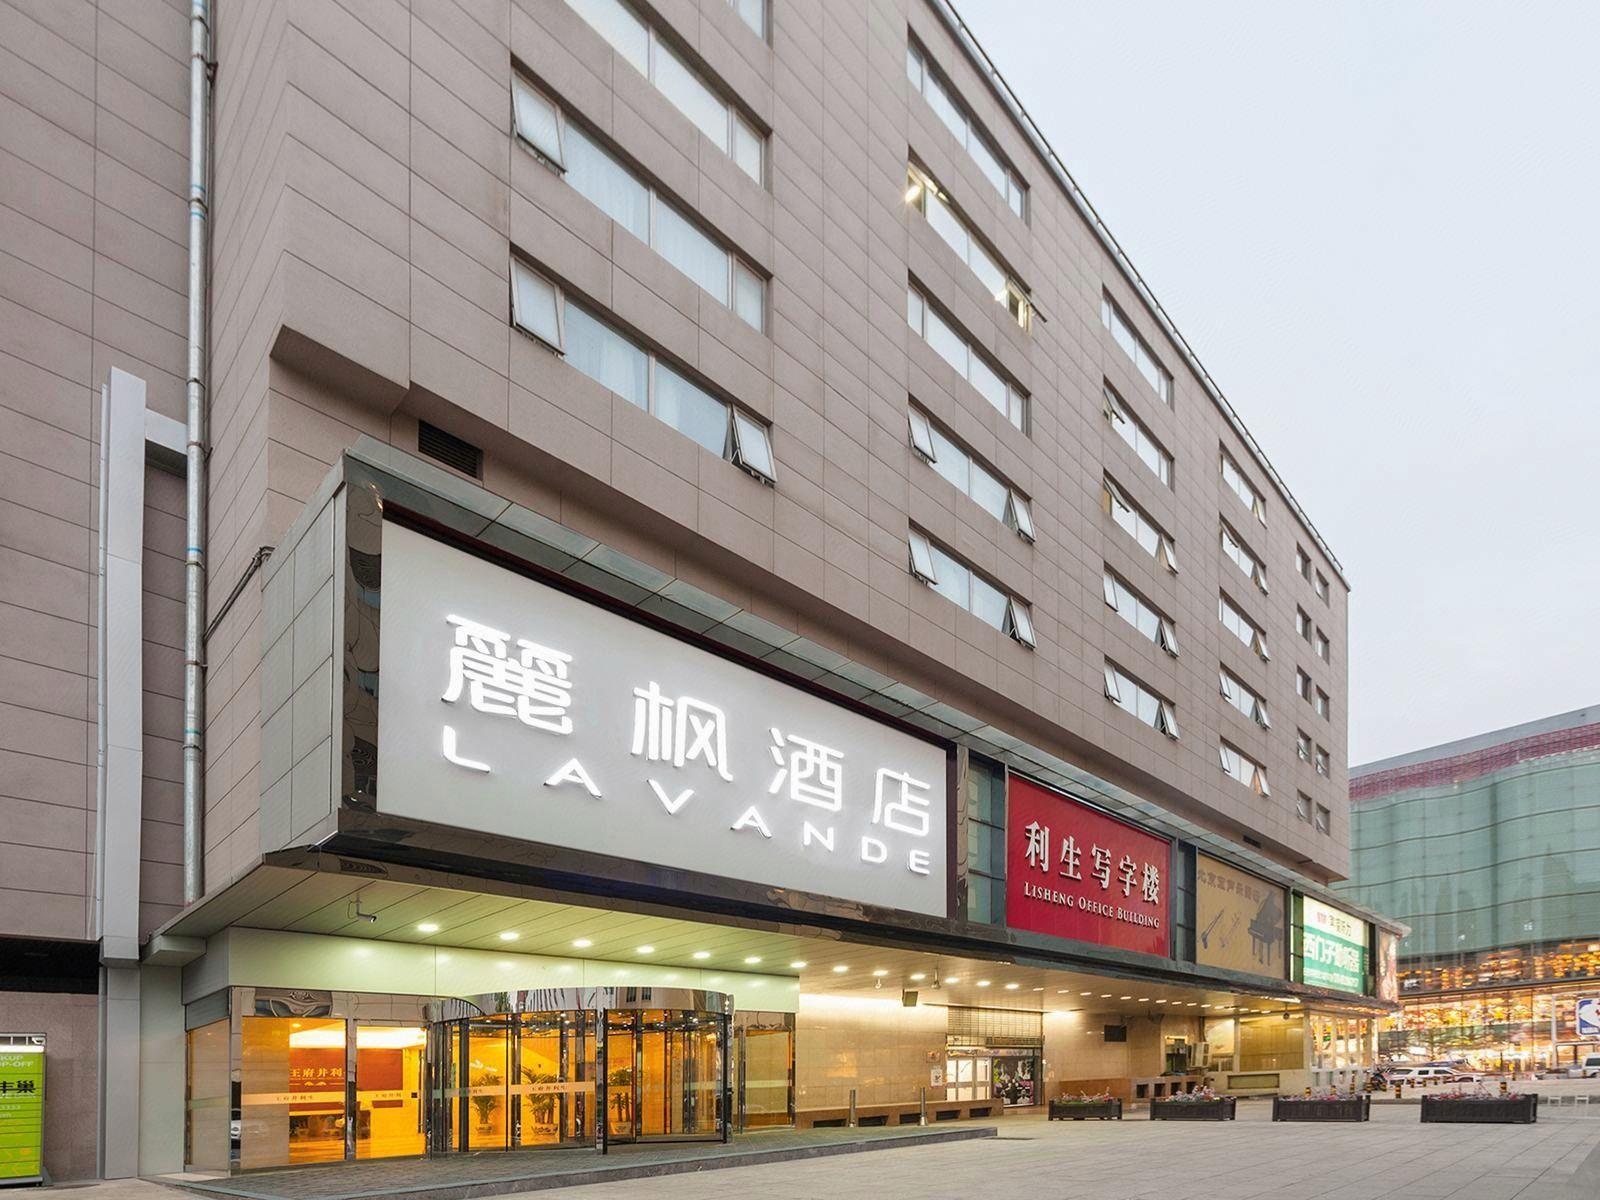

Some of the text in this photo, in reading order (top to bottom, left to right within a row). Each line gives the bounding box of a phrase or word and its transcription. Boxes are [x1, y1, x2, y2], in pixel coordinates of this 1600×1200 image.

[442, 726, 932, 876] LAVANDE
[1024, 820, 1161, 905] 利生写字楼
[1024, 882, 1161, 929] LISHENG OFFICE BUILDING
[289, 1067, 345, 1078] 王府井利
